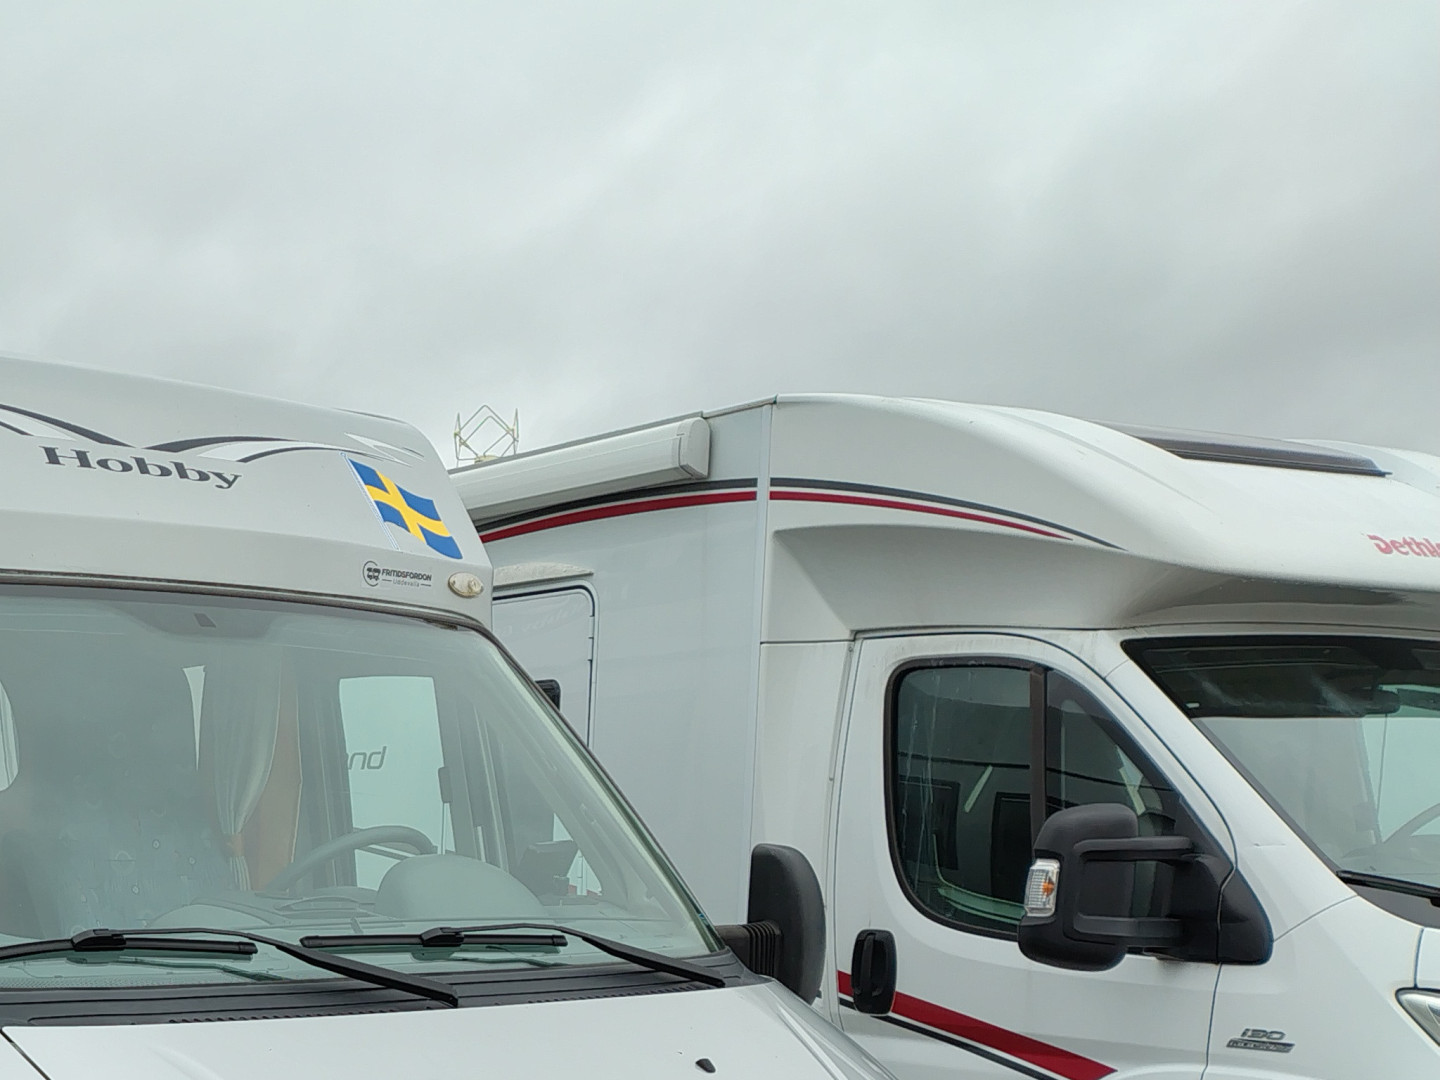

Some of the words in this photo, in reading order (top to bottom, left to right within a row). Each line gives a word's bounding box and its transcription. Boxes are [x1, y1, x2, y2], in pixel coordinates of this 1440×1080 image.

[39, 446, 242, 489] Hobby
[1366, 534, 1440, 558] Dethl
[381, 568, 432, 581] FRITIDSFORDON
[345, 745, 387, 770] nd
